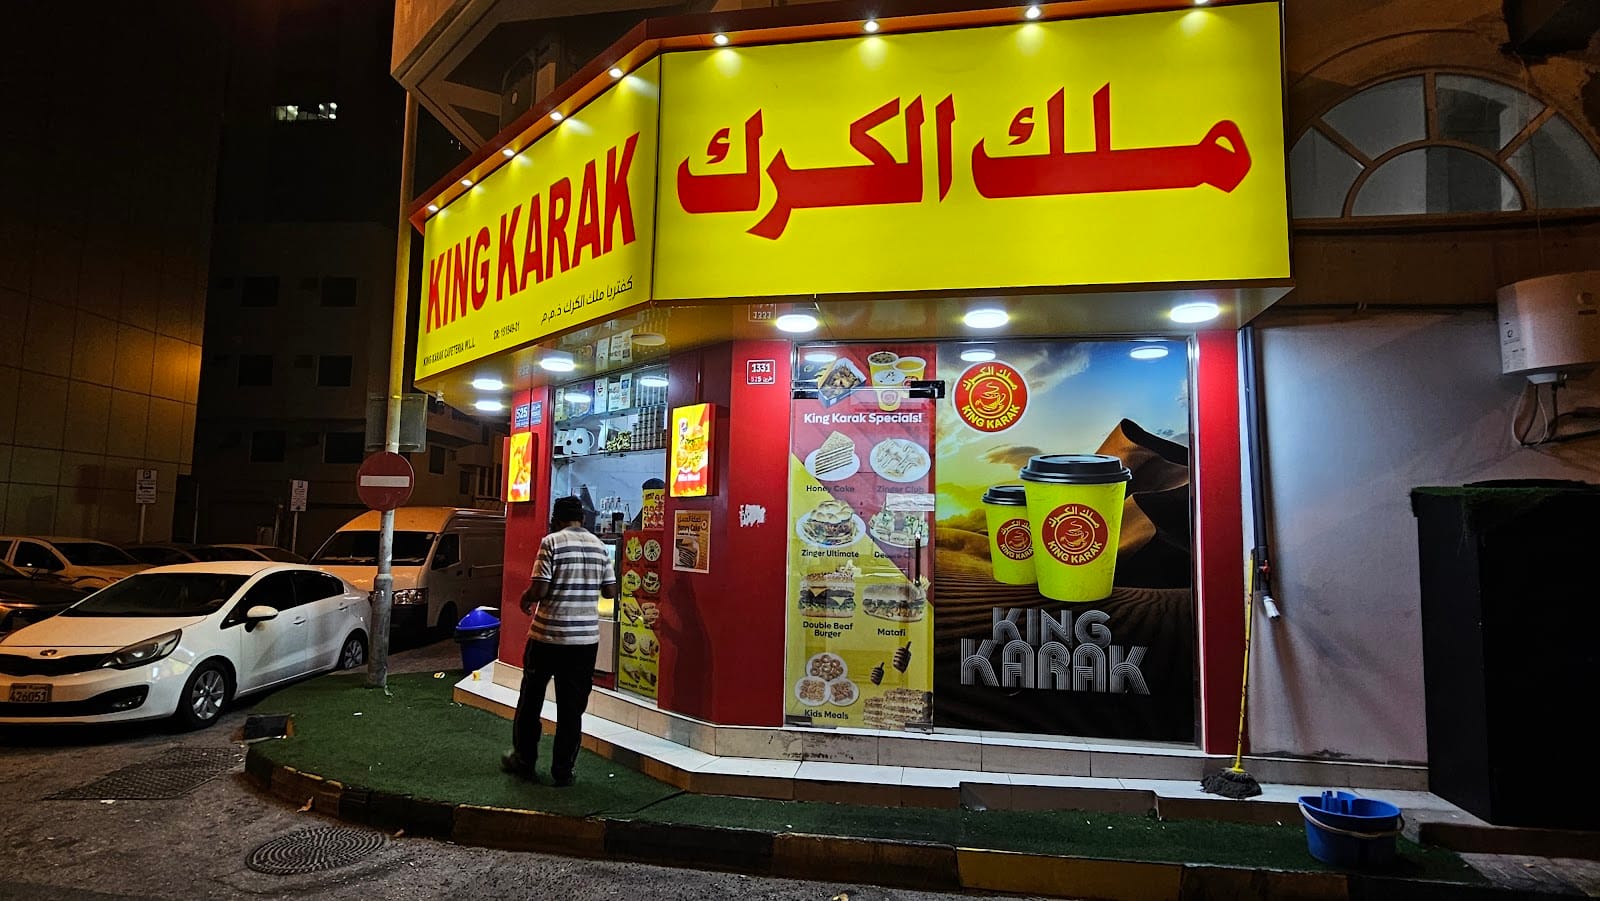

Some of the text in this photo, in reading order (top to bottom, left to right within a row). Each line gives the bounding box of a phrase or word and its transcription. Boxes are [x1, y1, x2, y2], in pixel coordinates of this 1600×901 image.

[676, 82, 1252, 241] ملك الكرك
[426, 131, 640, 333] KING KARAK
[564, 295, 585, 315] الكرك
[587, 289, 604, 305] ملك
[751, 363, 771, 373] 1331
[962, 365, 1018, 391] ملك الكرك
[804, 412, 923, 425] King Karak Specials!
[962, 404, 1020, 429] KING KARAK
[806, 485, 854, 493] Honey Cake
[1048, 506, 1100, 529] ملك الكرك
[801, 549, 859, 558] Zinger Ultimate
[1000, 543, 1034, 560] KING KARA
[1047, 540, 1103, 564] KING KARAK
[803, 621, 854, 630] Double Beaf
[814, 630, 841, 638] Burger
[877, 628, 906, 637] Matafi
[992, 606, 1112, 649] KING
[960, 637, 1151, 696] KARAK
[804, 709, 849, 719] Kids Meals
